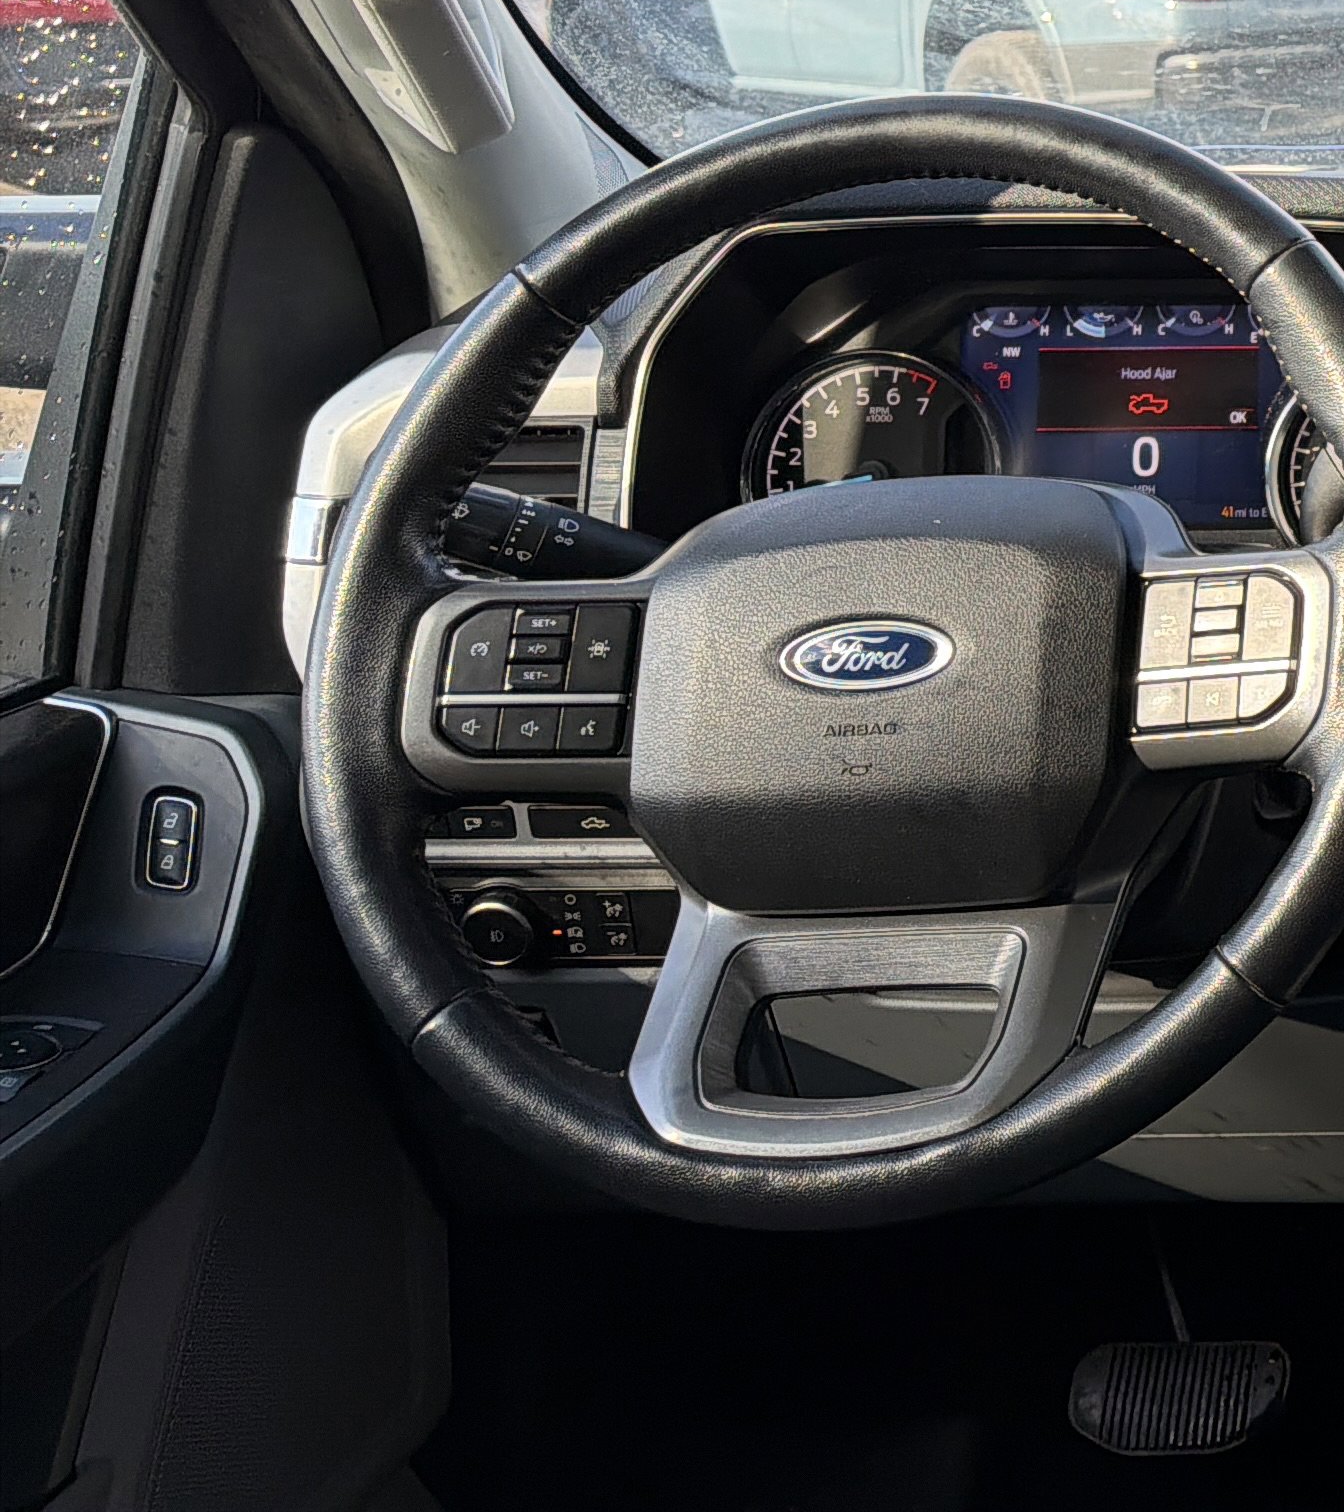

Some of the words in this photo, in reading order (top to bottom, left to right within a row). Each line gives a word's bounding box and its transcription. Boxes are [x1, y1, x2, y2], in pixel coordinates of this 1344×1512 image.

[972, 326, 981, 337] C
[1040, 325, 1049, 337] H
[1066, 325, 1074, 336] L
[1132, 324, 1142, 336] H
[1157, 324, 1166, 336] C
[1224, 323, 1234, 335] H
[1250, 332, 1258, 344] E
[1002, 346, 1022, 358] NW
[1121, 367, 1151, 380] Hood
[1154, 367, 1177, 381] Ajar
[855, 387, 870, 406] 5
[886, 387, 900, 406] 6
[825, 399, 840, 418] 4
[869, 406, 890, 415] RPM
[916, 397, 930, 416] 7
[1229, 411, 1247, 424] OK
[803, 420, 817, 439] 3
[788, 447, 802, 466] 2
[1132, 436, 1160, 477] 0
[1249, 507, 1260, 518] to
[531, 618, 557, 628] SET+
[821, 635, 910, 673] Ford
[523, 670, 548, 680] SET-
[822, 722, 898, 738] AIRBAG
